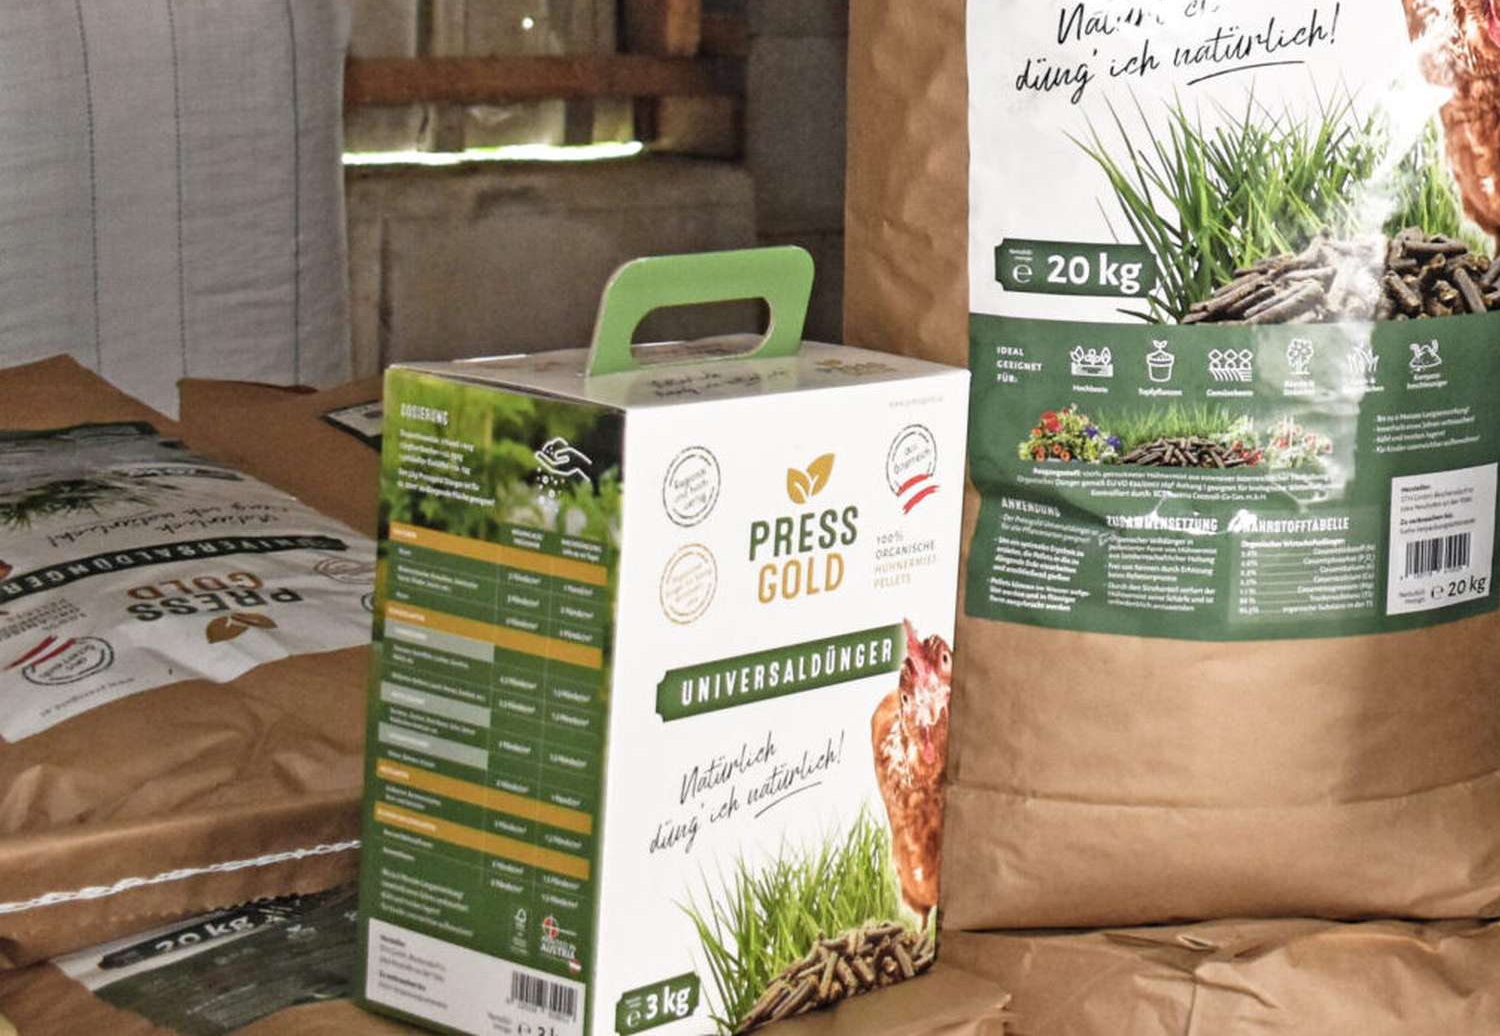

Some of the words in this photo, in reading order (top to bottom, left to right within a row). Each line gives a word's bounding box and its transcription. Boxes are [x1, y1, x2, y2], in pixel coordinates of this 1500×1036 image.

[1110, 39, 1160, 77] ich
[1174, 2, 1340, 68] natürlich!
[1047, 254, 1090, 285] 20
[1099, 252, 1142, 294] kg
[996, 347, 1024, 357] IDEAL
[749, 505, 858, 562] PRESS
[875, 540, 935, 561] ORGANISCHE
[876, 530, 903, 545] 100%
[127, 571, 264, 600] GOLD
[758, 553, 845, 604] GOLD
[1448, 580, 1466, 597] 20
[1469, 575, 1487, 594] kg
[126, 588, 303, 622] PRESS
[681, 638, 893, 706] UNIVERSALDÜNGER
[679, 731, 776, 805] Natürlich
[710, 786, 740, 824] ich
[747, 729, 845, 805] natürlich!
[204, 915, 254, 938] kg
[646, 993, 658, 1020] 3
[664, 985, 691, 1016] kg
